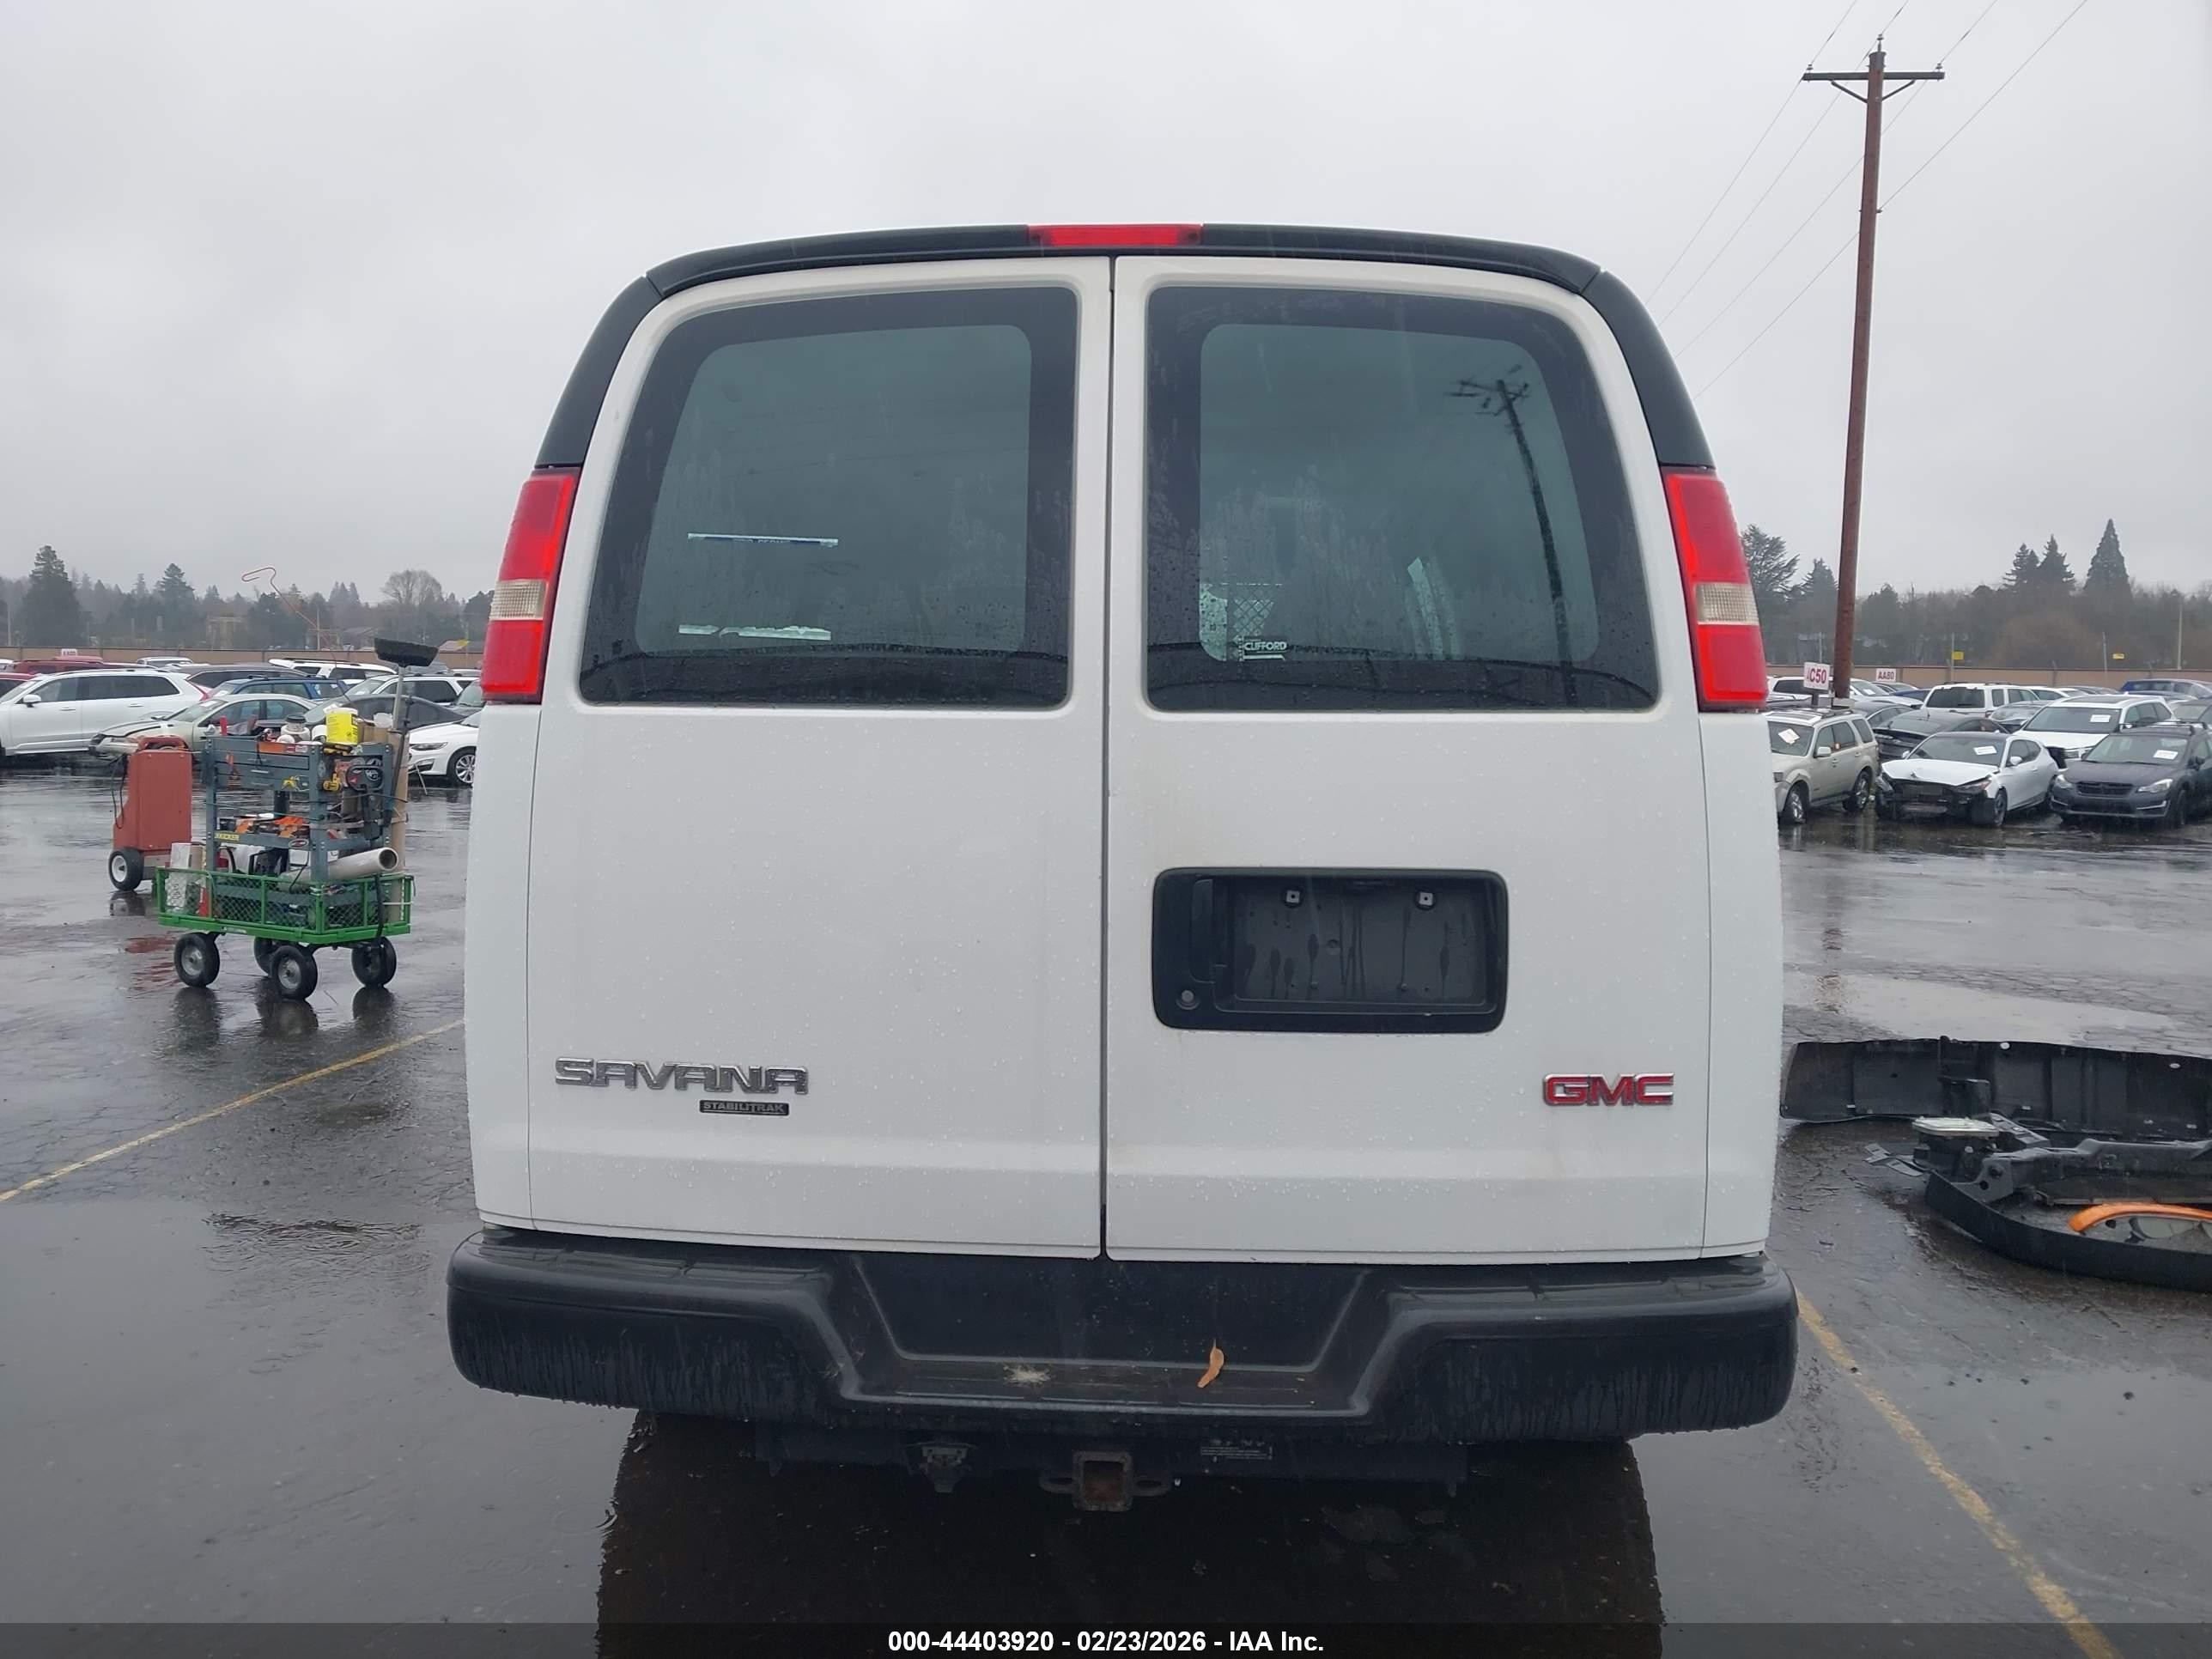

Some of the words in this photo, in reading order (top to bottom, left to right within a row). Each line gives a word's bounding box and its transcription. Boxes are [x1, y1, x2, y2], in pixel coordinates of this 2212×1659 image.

[1243, 641, 1287, 651] CLIFFORD
[555, 1056, 809, 1095] SAVANA
[1543, 1073, 1675, 1106] GMC
[703, 1101, 785, 1114] STABILITRAK
